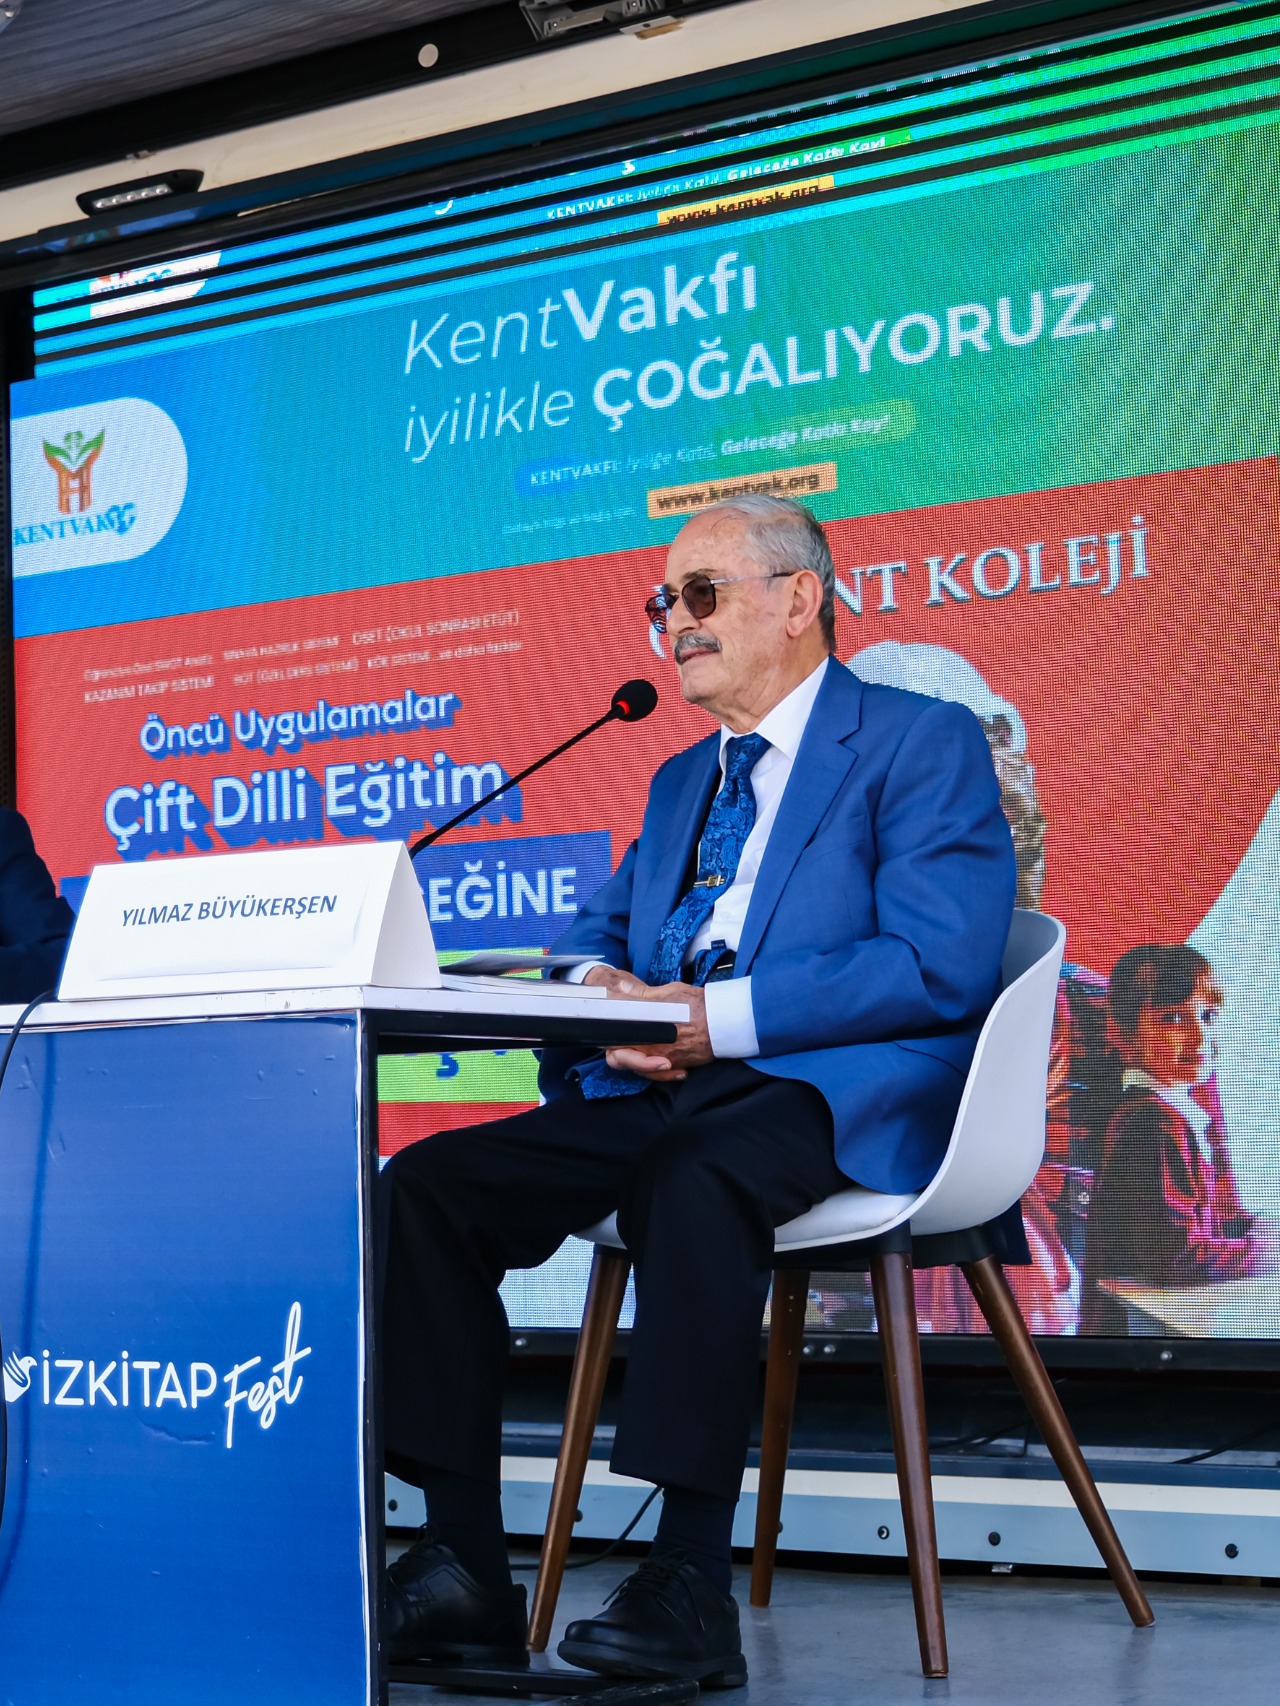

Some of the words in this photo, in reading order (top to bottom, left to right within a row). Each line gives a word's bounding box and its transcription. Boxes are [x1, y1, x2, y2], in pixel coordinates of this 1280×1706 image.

[404, 381, 574, 464] iyilikle
[592, 281, 1117, 433] ÇOĞALIYORUZ.
[923, 515, 1150, 608] KOLEJİ
[139, 714, 223, 756] Öncü
[233, 690, 456, 748] Uygulamalar
[104, 778, 198, 852] Çift
[212, 768, 307, 828] Dilli
[325, 752, 505, 826] Eğitim
[122, 903, 194, 927] YILMAZ
[197, 894, 338, 920] BÜYÜKERŞEN
[421, 859, 578, 921] EĞİNE
[42, 1349, 218, 1409] İZKİTAP
[223, 1301, 312, 1449] Fest
